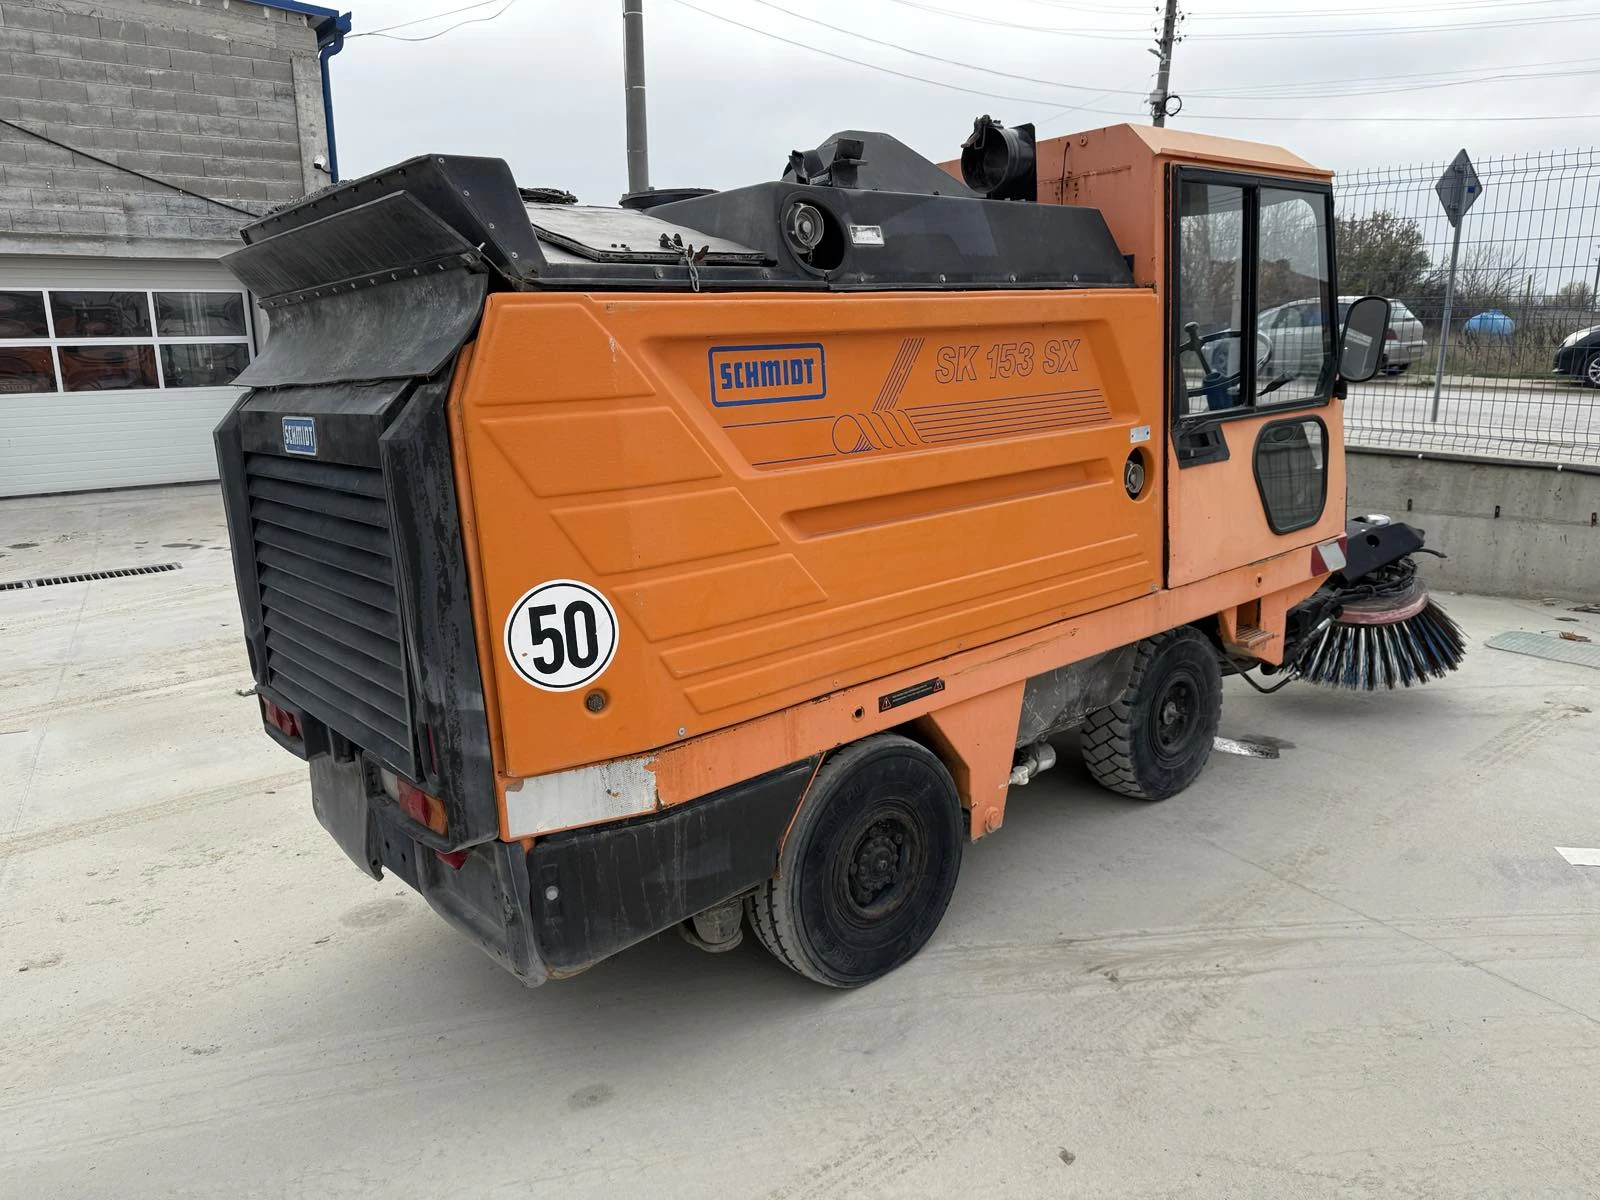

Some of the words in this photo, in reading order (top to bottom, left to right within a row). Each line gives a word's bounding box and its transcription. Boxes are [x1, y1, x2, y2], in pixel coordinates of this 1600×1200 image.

[720, 358, 815, 390] SCHMIDT
[935, 345, 980, 384] SK
[986, 341, 1035, 379] 153
[1042, 338, 1081, 375] SX
[284, 424, 314, 447] SCHMIDT
[528, 600, 599, 675] 50
